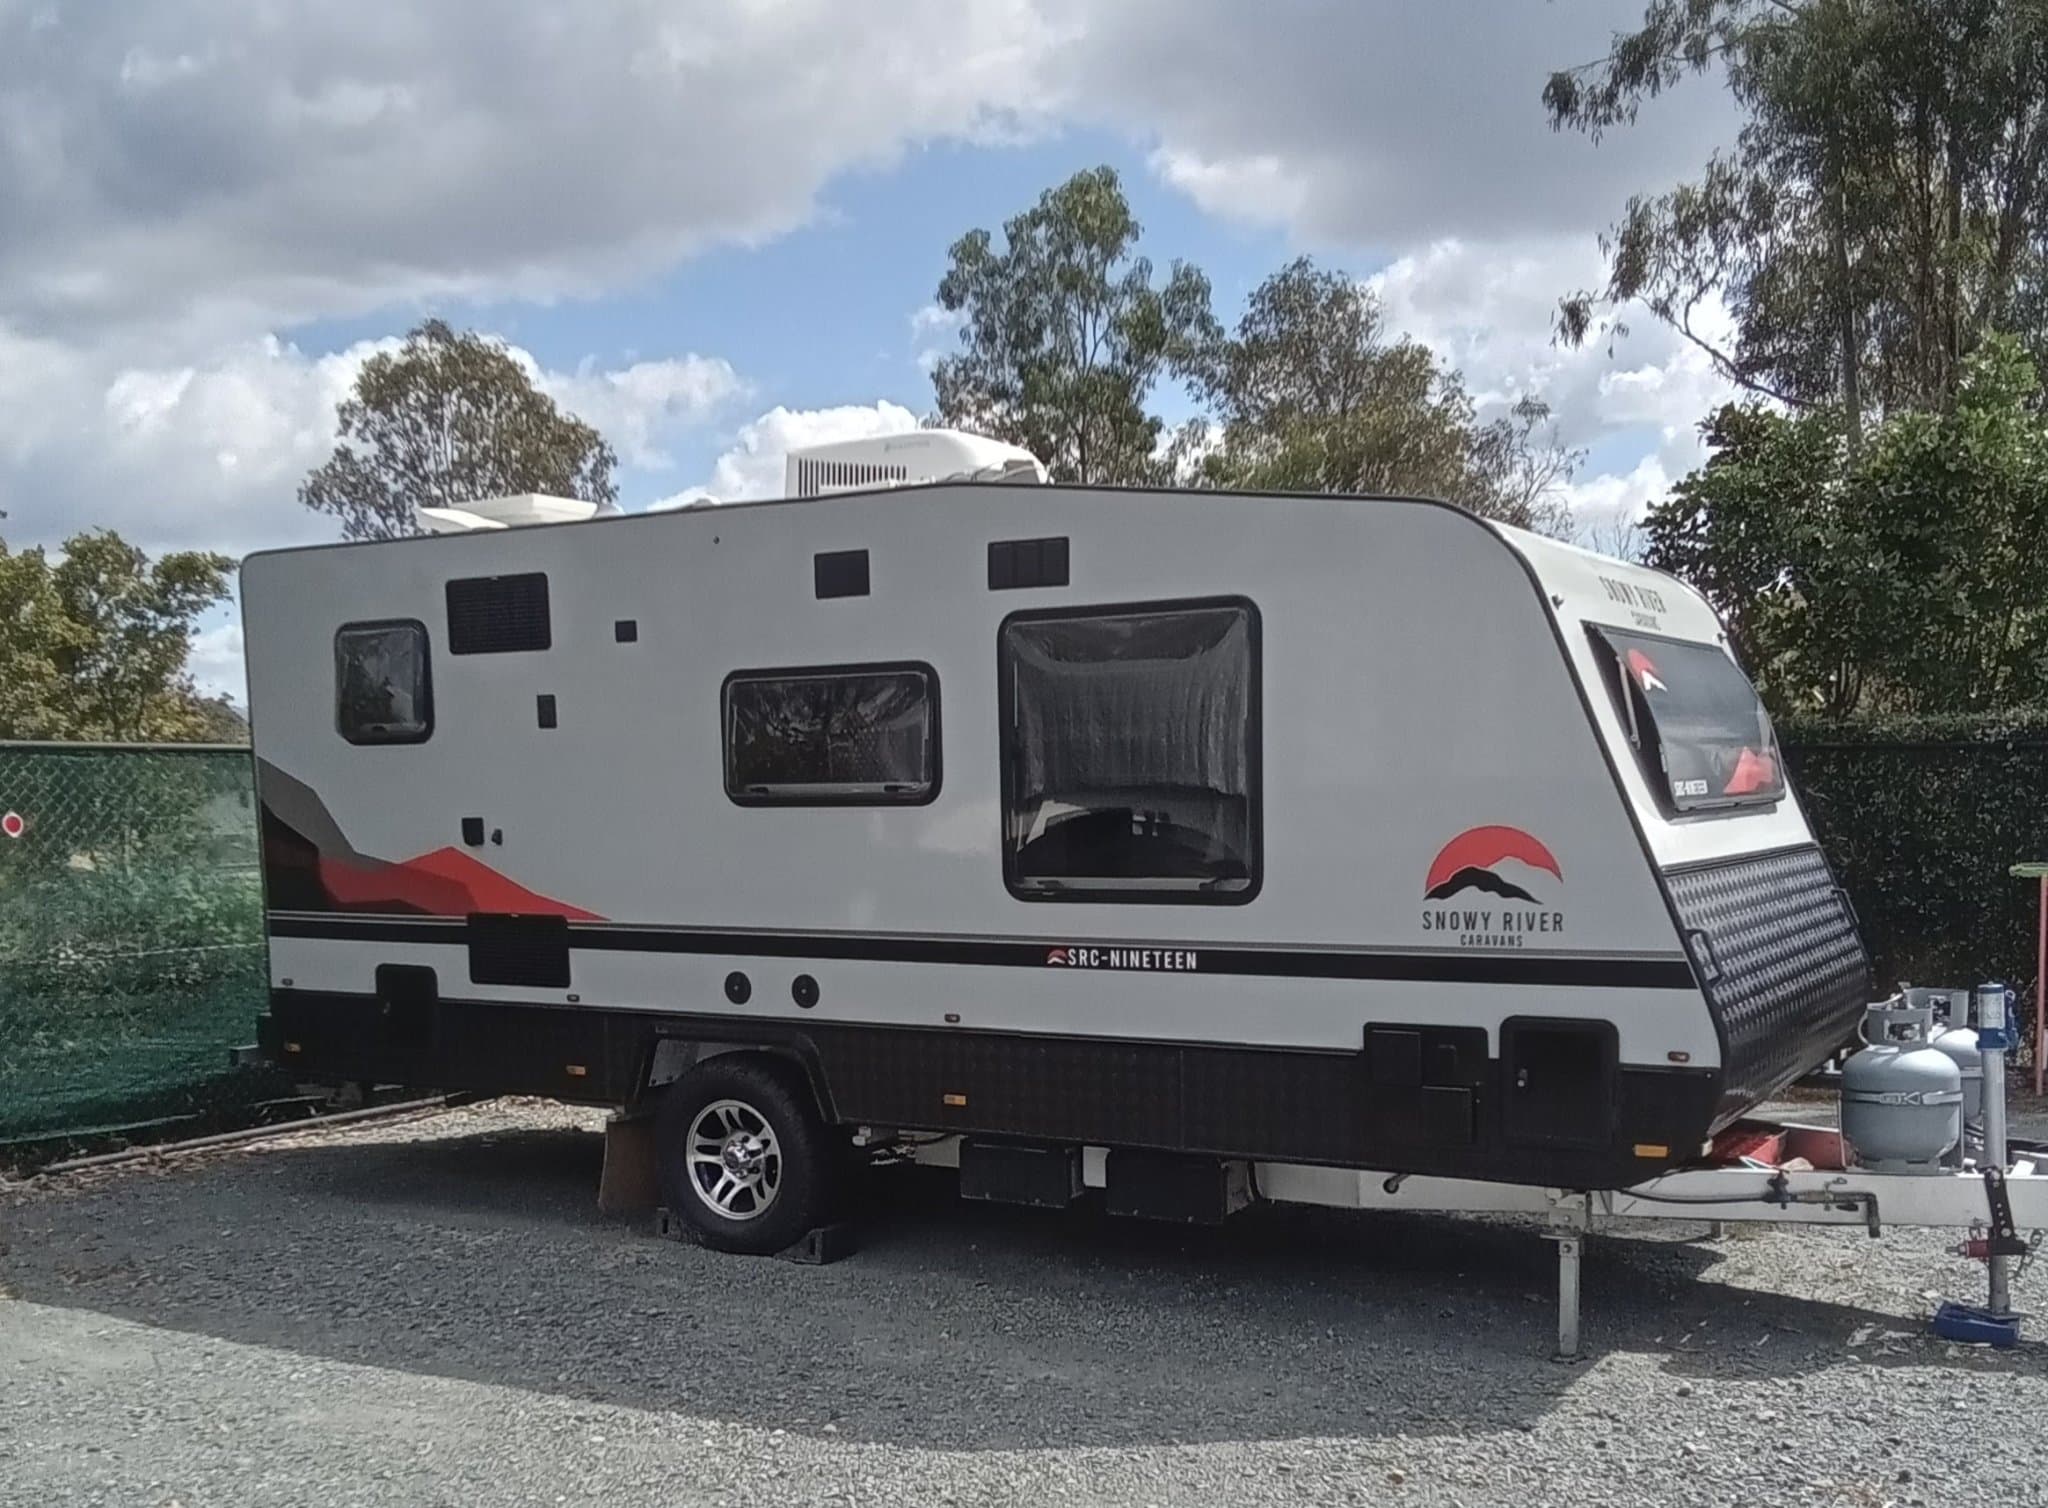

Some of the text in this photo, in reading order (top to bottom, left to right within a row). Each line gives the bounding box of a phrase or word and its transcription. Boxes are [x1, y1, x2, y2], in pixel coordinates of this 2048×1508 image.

[1634, 585, 1667, 614] RIVER
[1422, 911, 1564, 932] SNOWY RIVER
[1460, 934, 1523, 947] CARAVANS
[1067, 948, 1197, 969] SRC-NINETEEN
